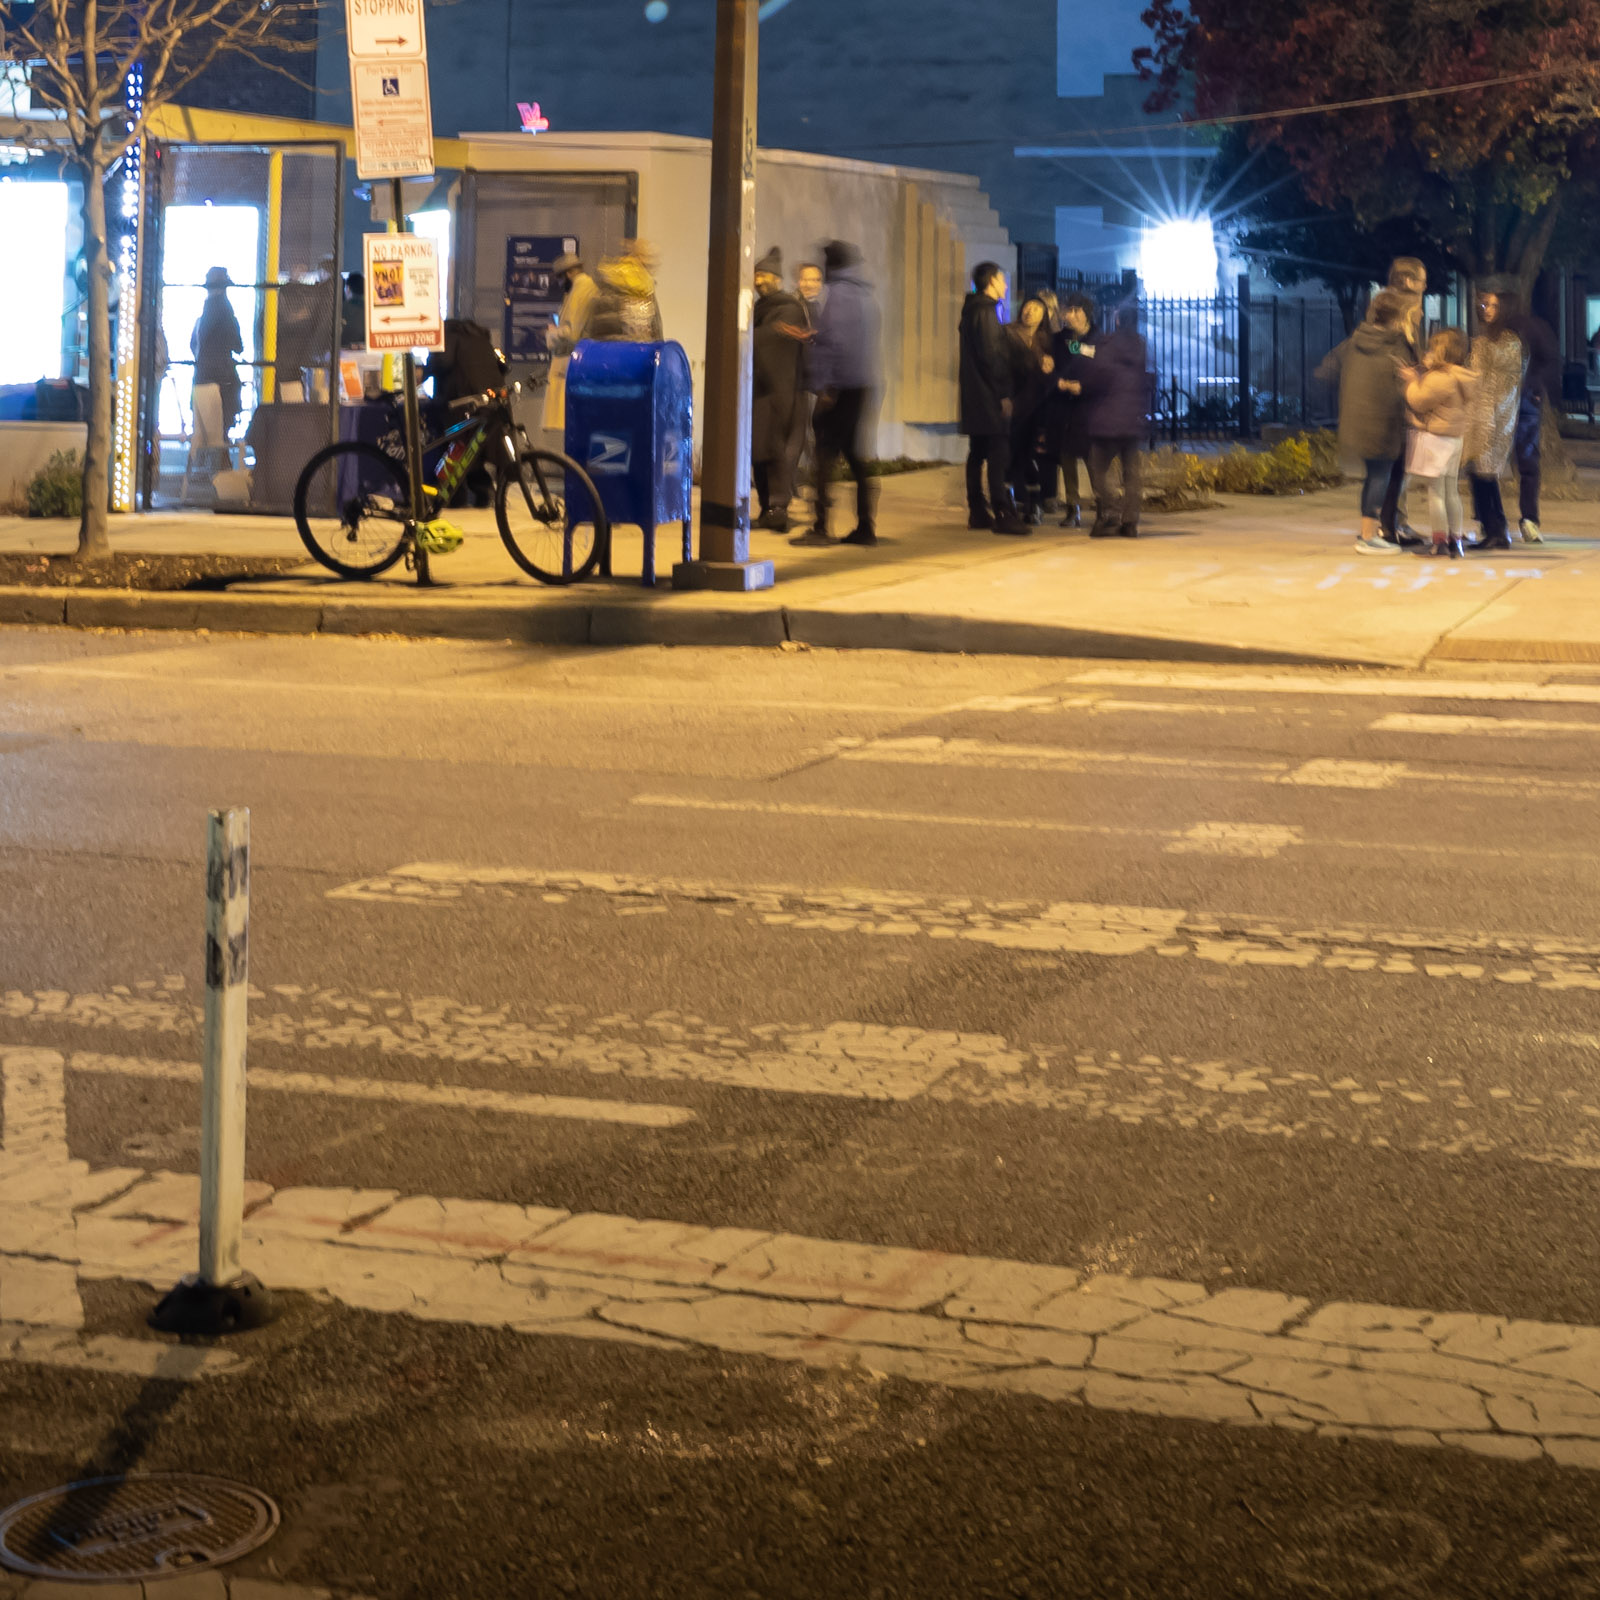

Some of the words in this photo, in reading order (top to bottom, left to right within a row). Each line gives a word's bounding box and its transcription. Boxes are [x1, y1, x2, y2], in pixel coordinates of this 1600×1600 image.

[373, 245, 387, 258] NO
[390, 243, 433, 259] PARKING
[374, 334, 392, 348] TOW
[392, 333, 415, 347] AWAY
[415, 332, 436, 346] ZONE
